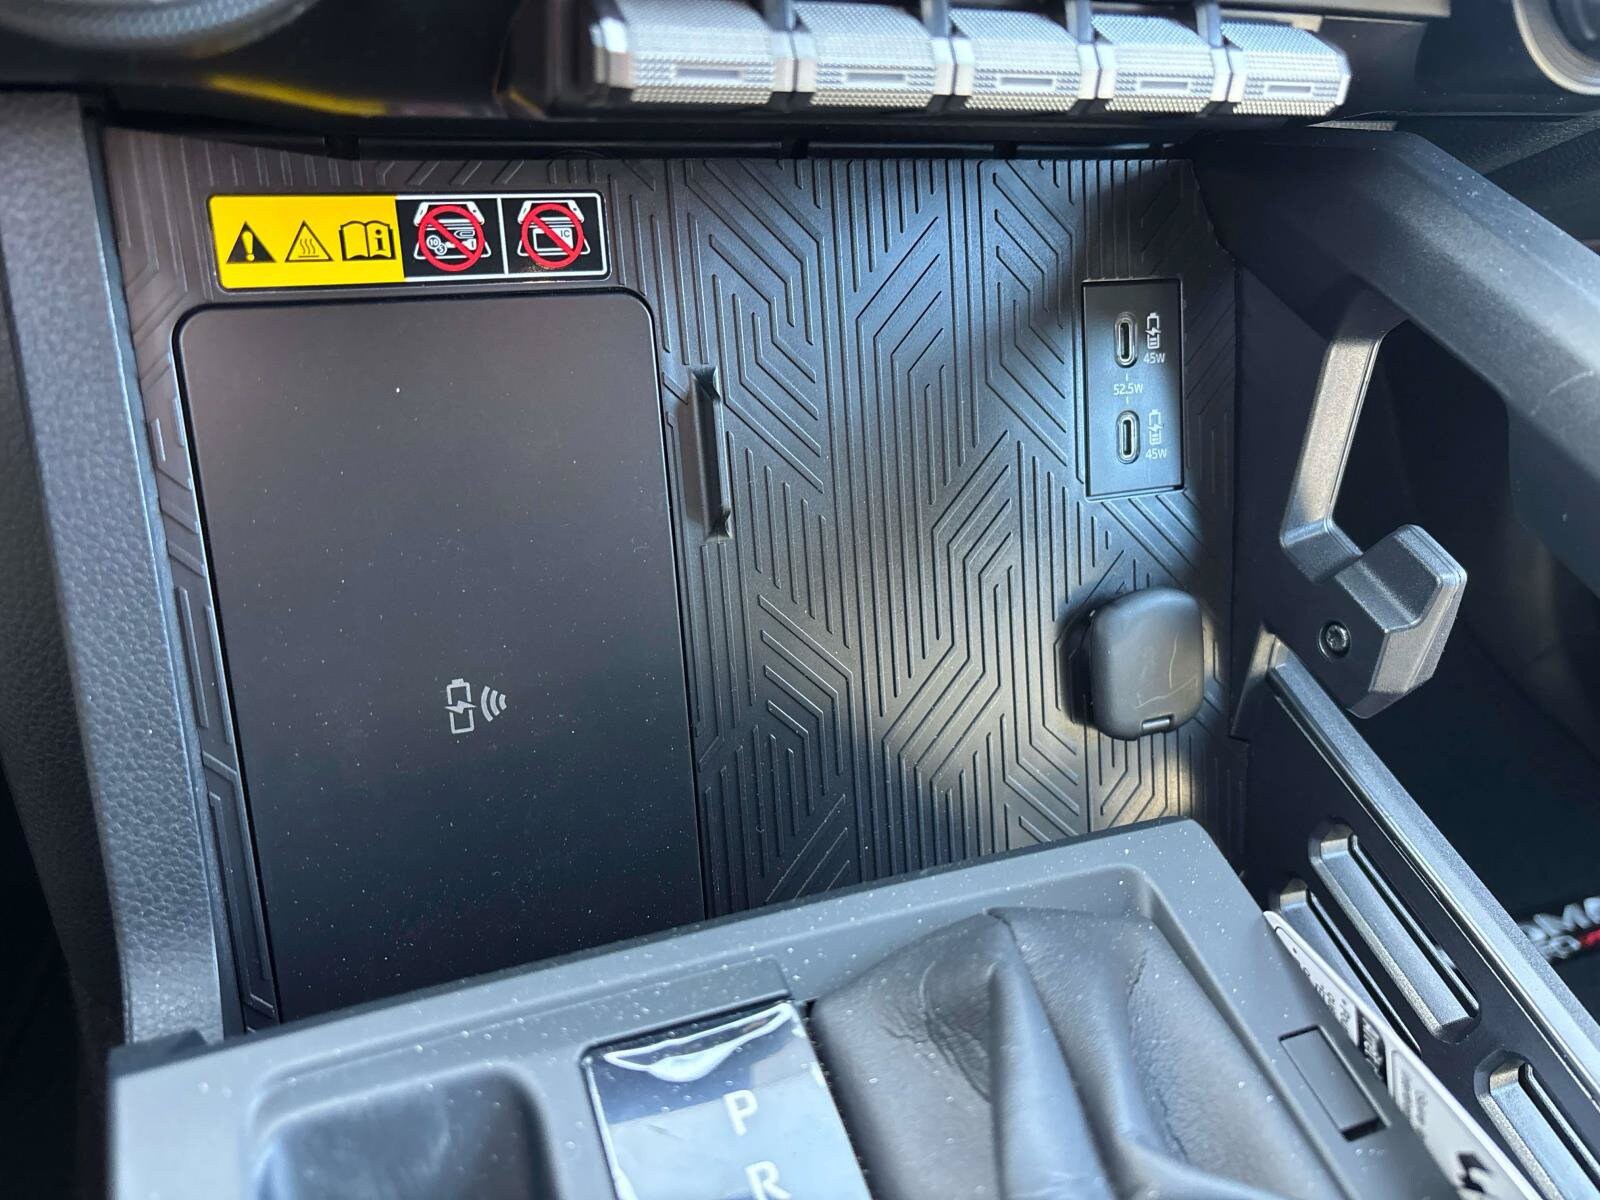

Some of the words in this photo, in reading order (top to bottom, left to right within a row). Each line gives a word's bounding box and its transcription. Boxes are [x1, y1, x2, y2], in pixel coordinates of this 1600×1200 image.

[560, 229, 571, 238] IC
[1143, 352, 1166, 364] 45W
[1113, 384, 1144, 396] 52.5W
[1145, 447, 1168, 460] 45W
[722, 1089, 758, 1137] P
[745, 1160, 791, 1200] R
